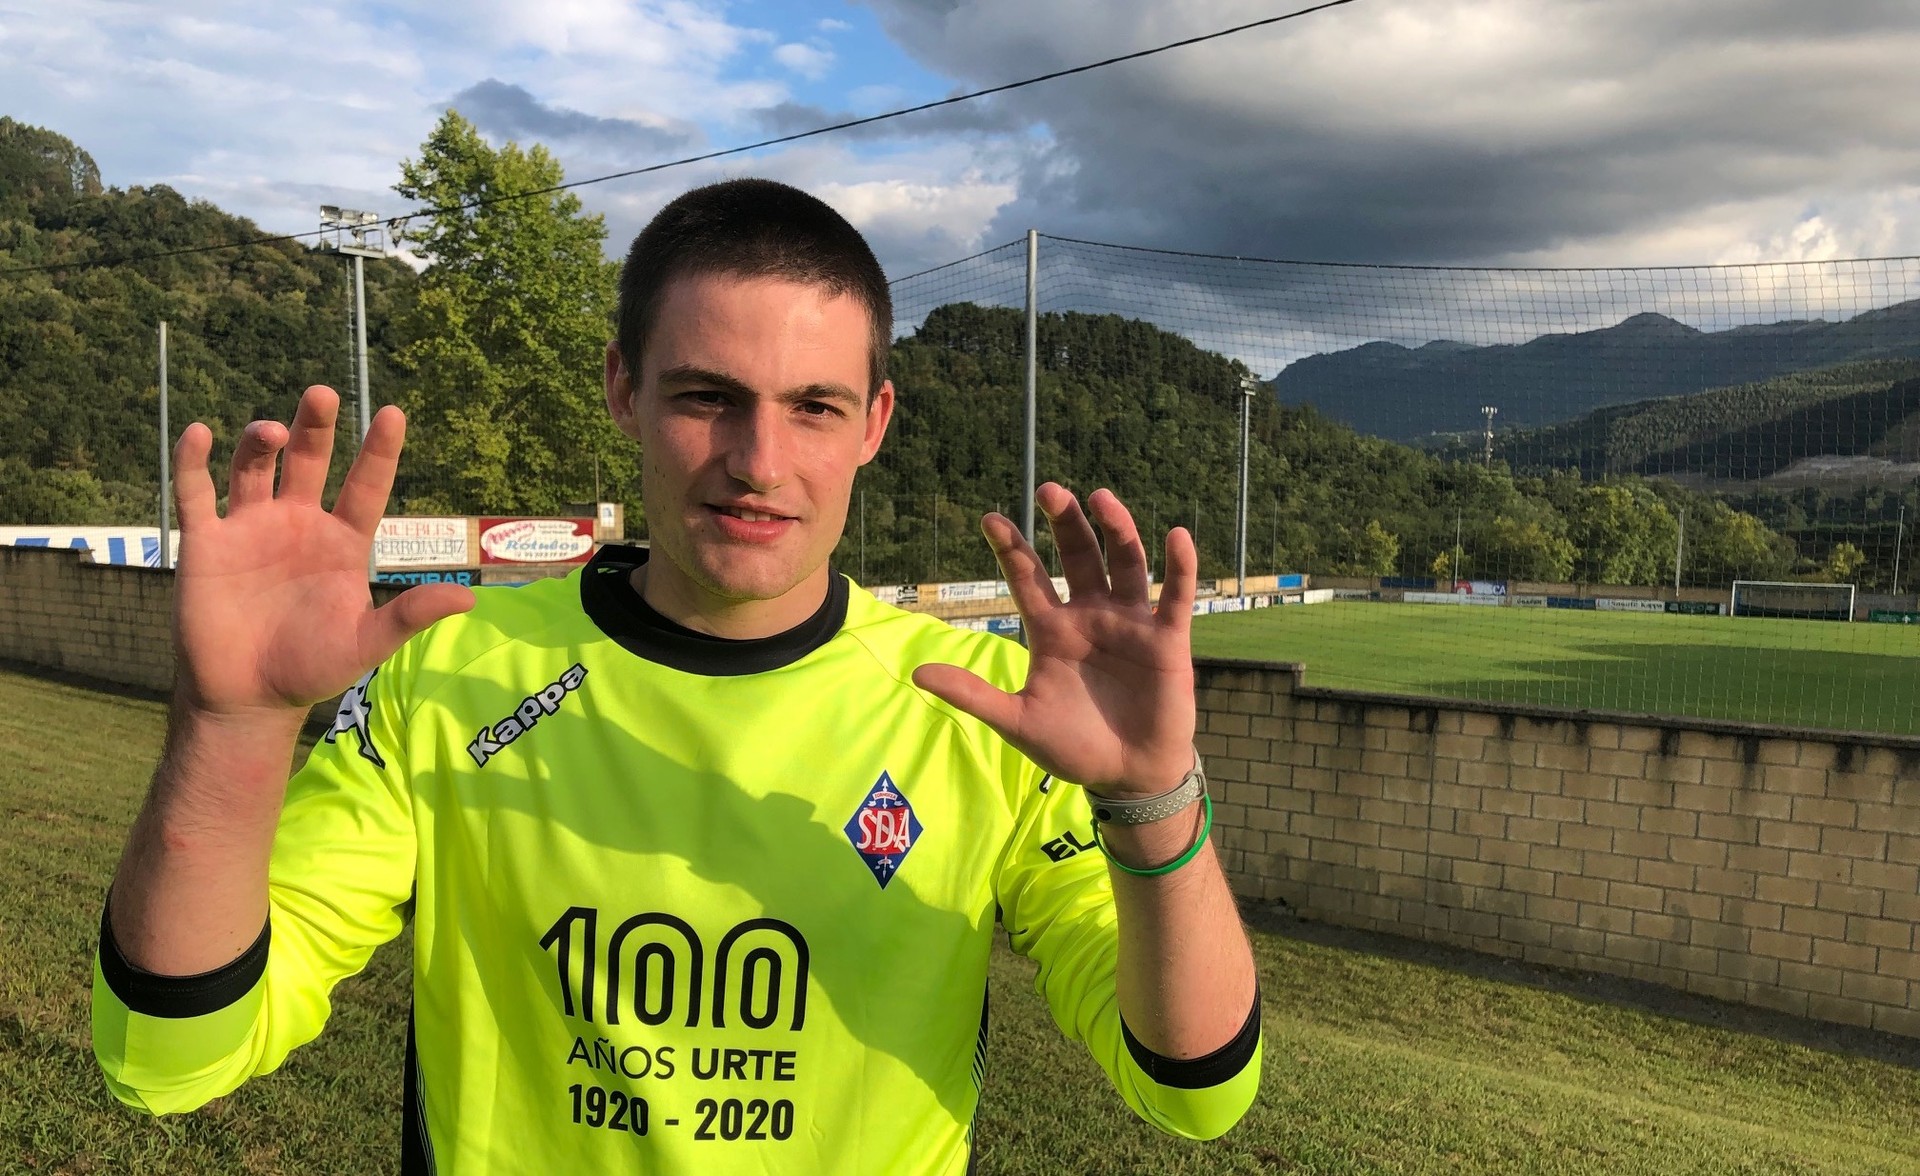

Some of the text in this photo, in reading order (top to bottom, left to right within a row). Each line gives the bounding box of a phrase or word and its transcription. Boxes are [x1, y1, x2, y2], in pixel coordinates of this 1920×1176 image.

[380, 522, 456, 537] MUEBLES
[466, 662, 588, 768] Kappa
[856, 808, 911, 849] SDA
[538, 906, 811, 1032] 100
[566, 1036, 797, 1081] AÑOS URTE
[568, 1083, 795, 1142] 1920 - 2020
